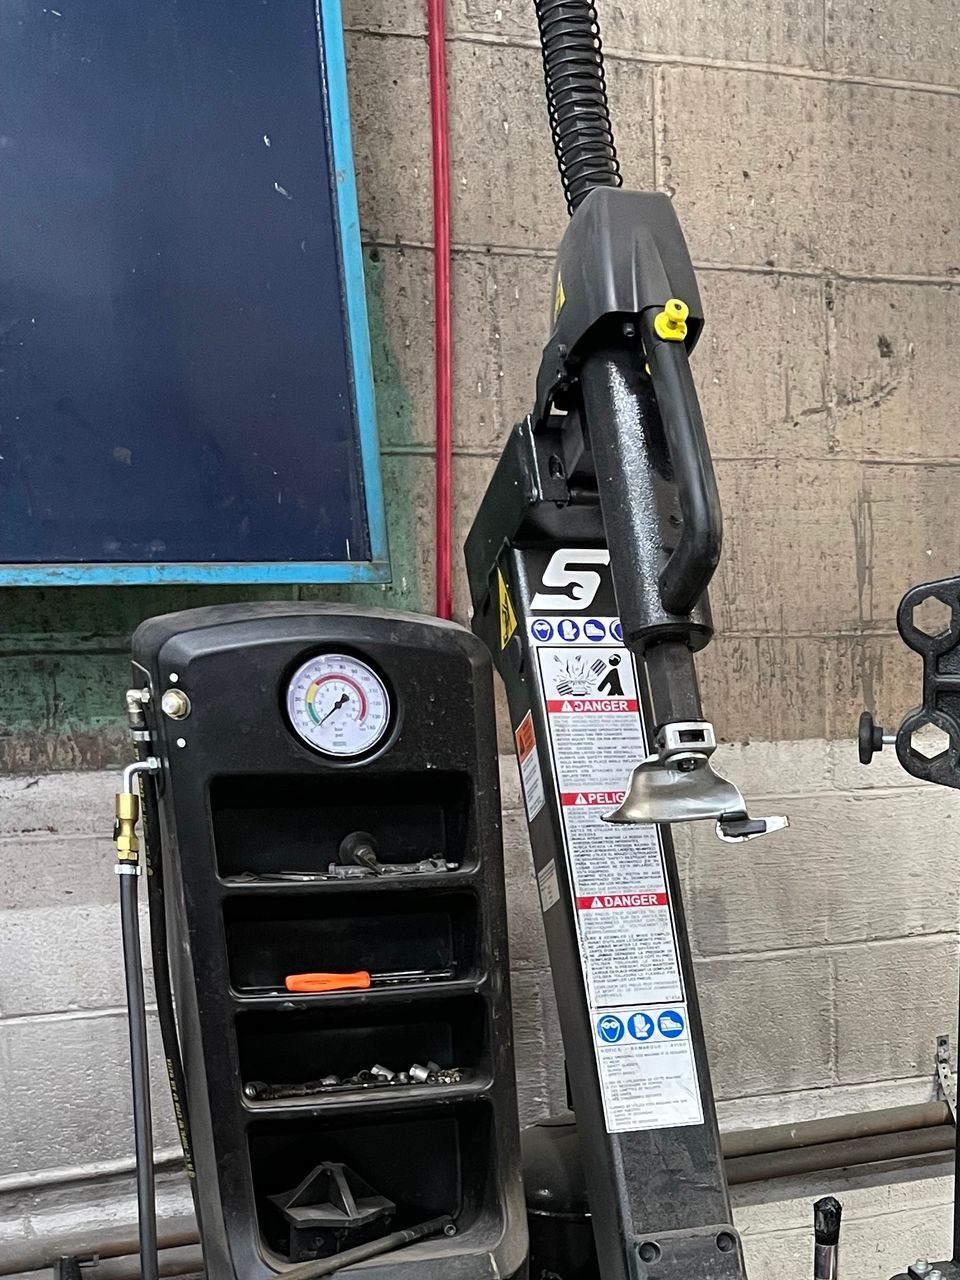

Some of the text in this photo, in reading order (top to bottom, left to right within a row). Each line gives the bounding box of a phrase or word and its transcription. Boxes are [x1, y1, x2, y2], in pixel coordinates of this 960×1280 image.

[573, 700, 629, 712] DANGER
[588, 792, 626, 804] PELIG
[604, 894, 658, 908] DANGER
